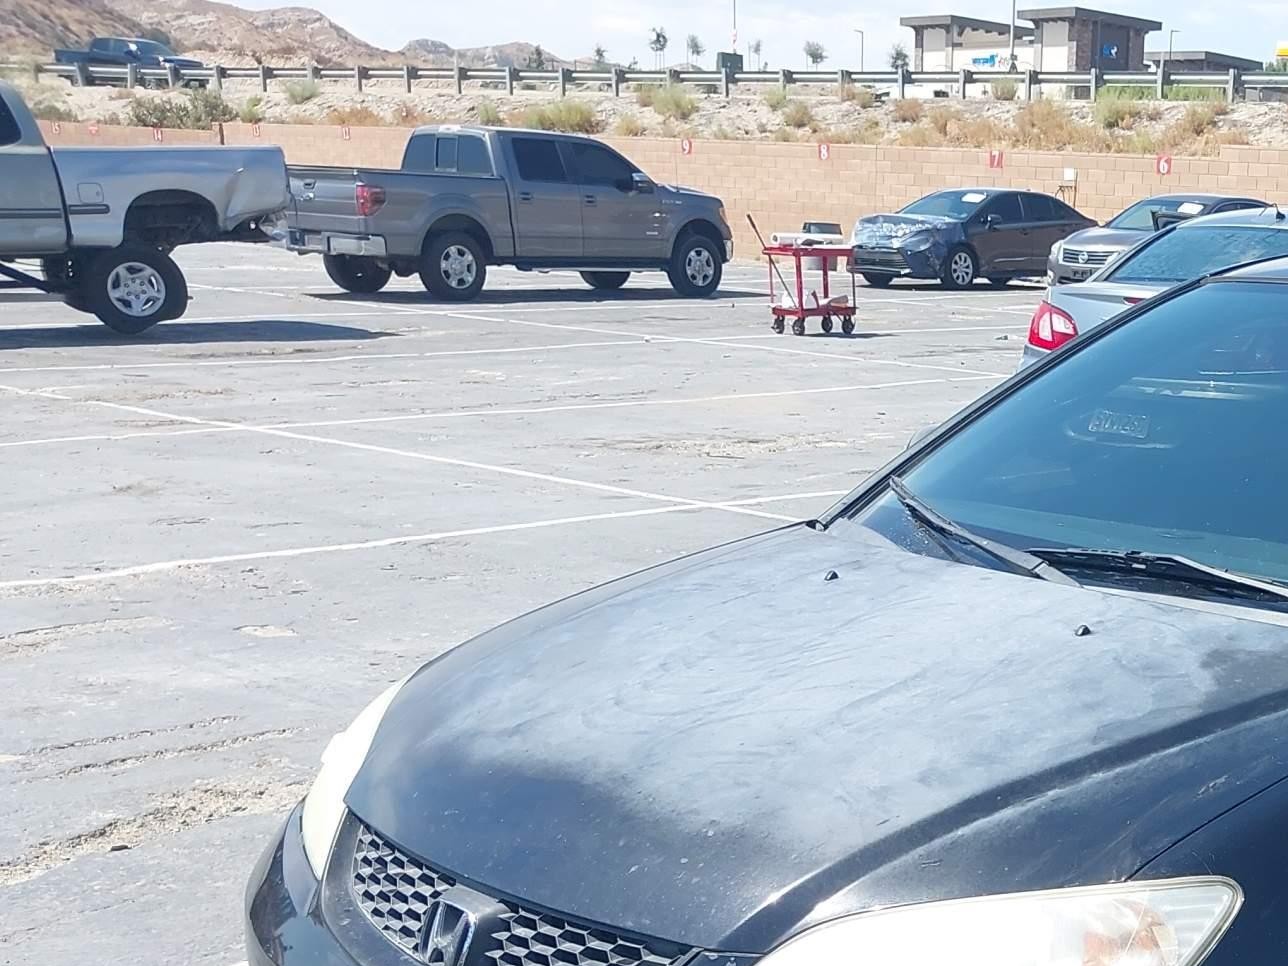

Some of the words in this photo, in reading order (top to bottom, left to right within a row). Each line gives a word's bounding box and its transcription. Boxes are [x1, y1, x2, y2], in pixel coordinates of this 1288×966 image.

[682, 139, 690, 154] 9
[820, 144, 828, 159] 8
[991, 151, 1000, 168] 7
[1159, 156, 1168, 173] 6
